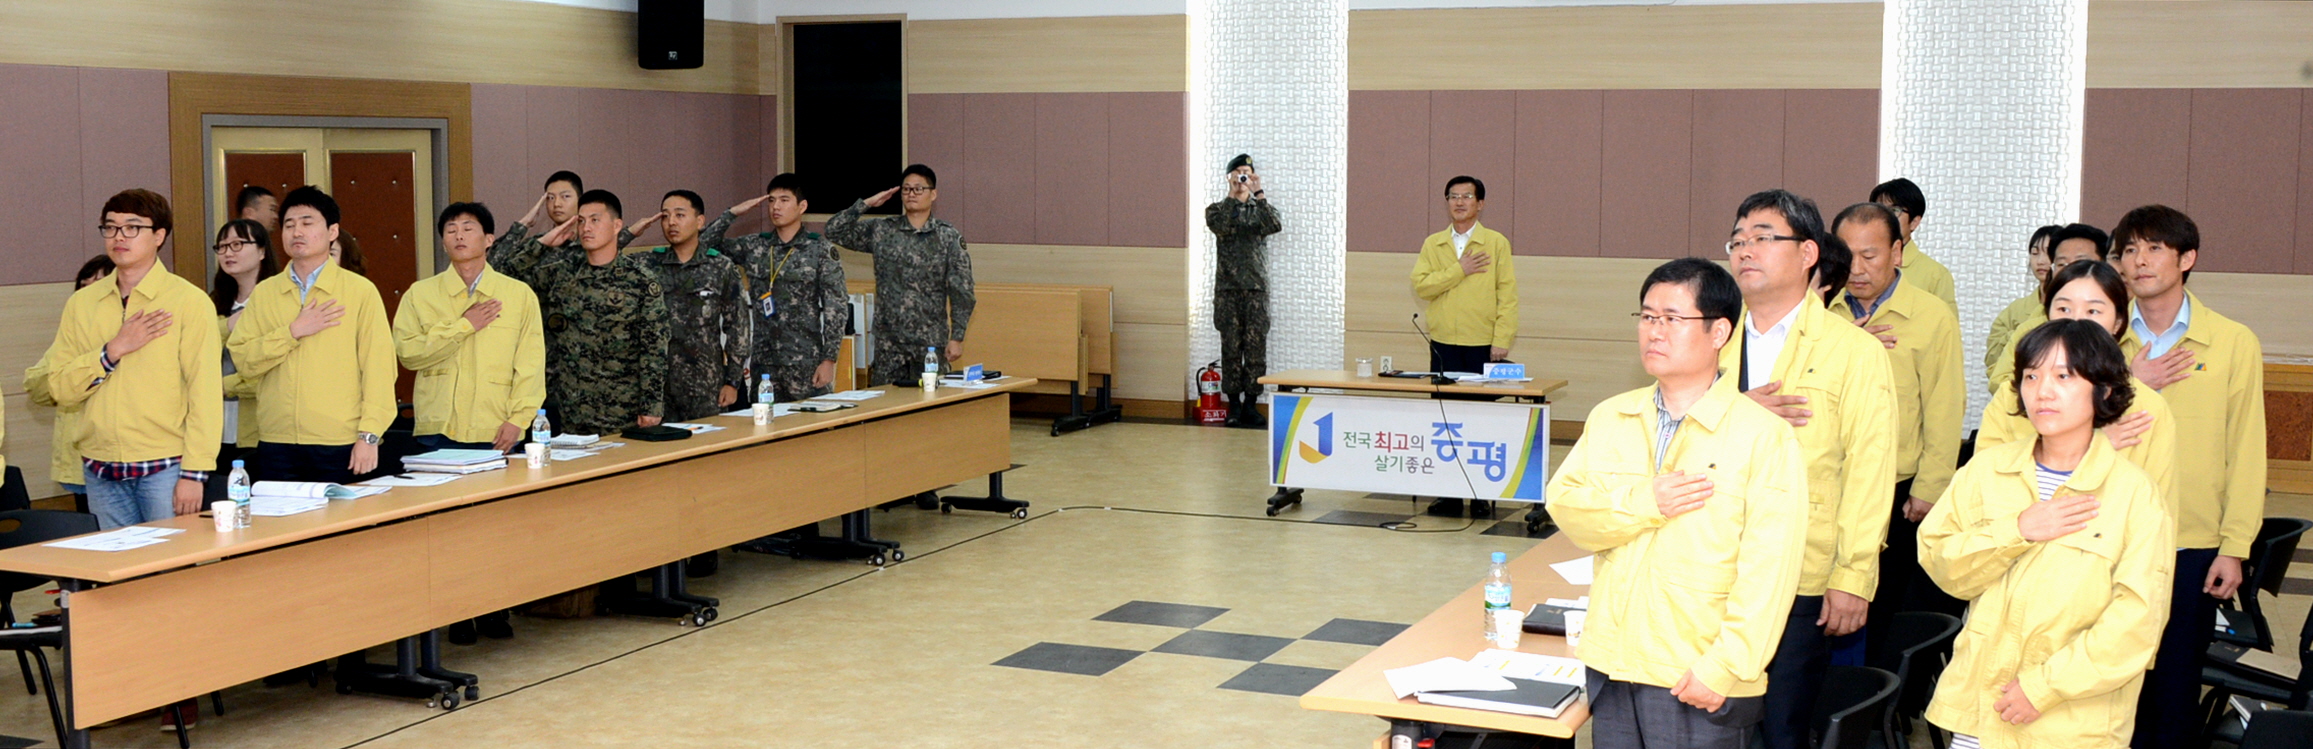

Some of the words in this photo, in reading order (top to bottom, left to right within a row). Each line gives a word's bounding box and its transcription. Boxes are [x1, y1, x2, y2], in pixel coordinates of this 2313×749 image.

[1343, 431, 1372, 449] 전국
[1374, 431, 1424, 453] 최고의
[1431, 422, 1507, 483] 증평
